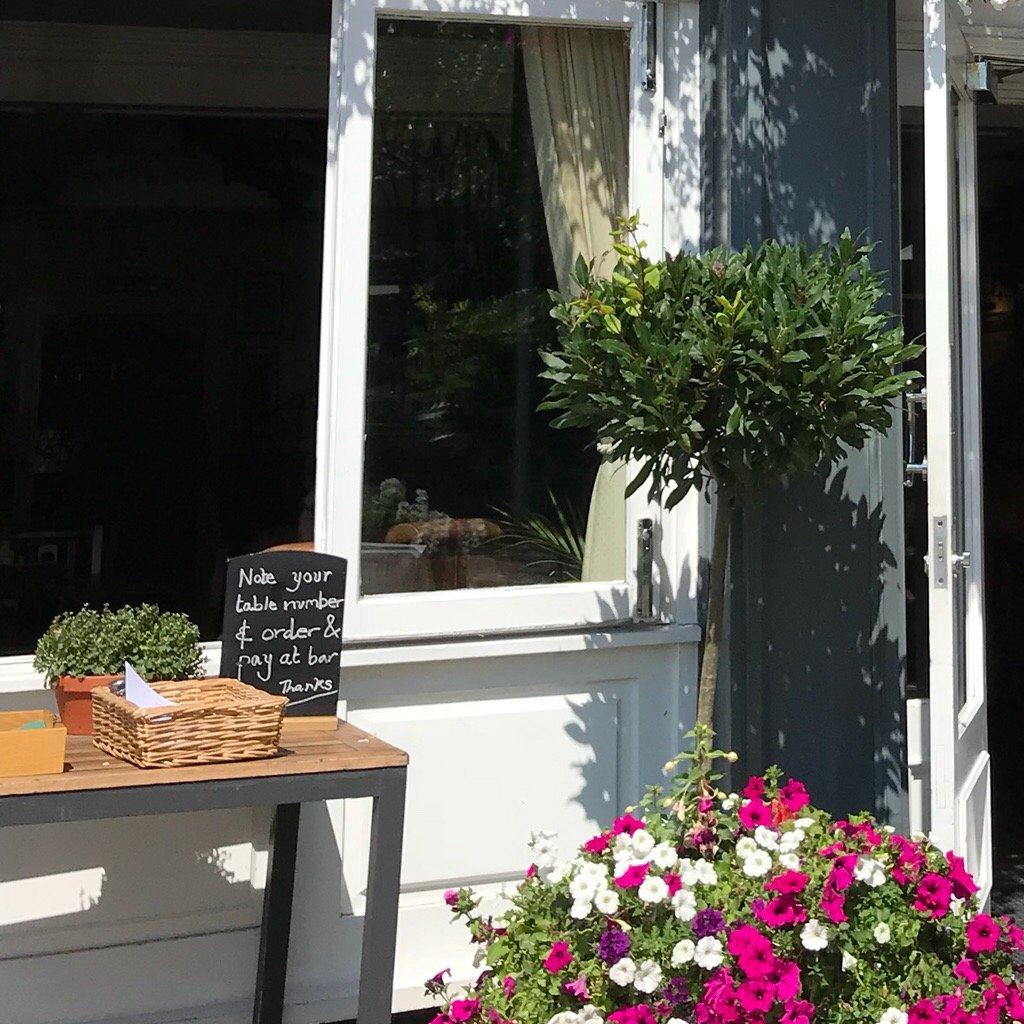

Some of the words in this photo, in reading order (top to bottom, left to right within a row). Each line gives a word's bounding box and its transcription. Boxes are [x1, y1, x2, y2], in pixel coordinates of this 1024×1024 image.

[238, 567, 277, 588] Note
[286, 570, 333, 592] your
[235, 593, 278, 613] table
[283, 590, 344, 611] number
[261, 617, 321, 641] order
[323, 614, 342, 639] &
[237, 652, 273, 682] pay
[279, 645, 301, 665] at
[308, 646, 339, 666] bar
[279, 677, 333, 694] Thanks
